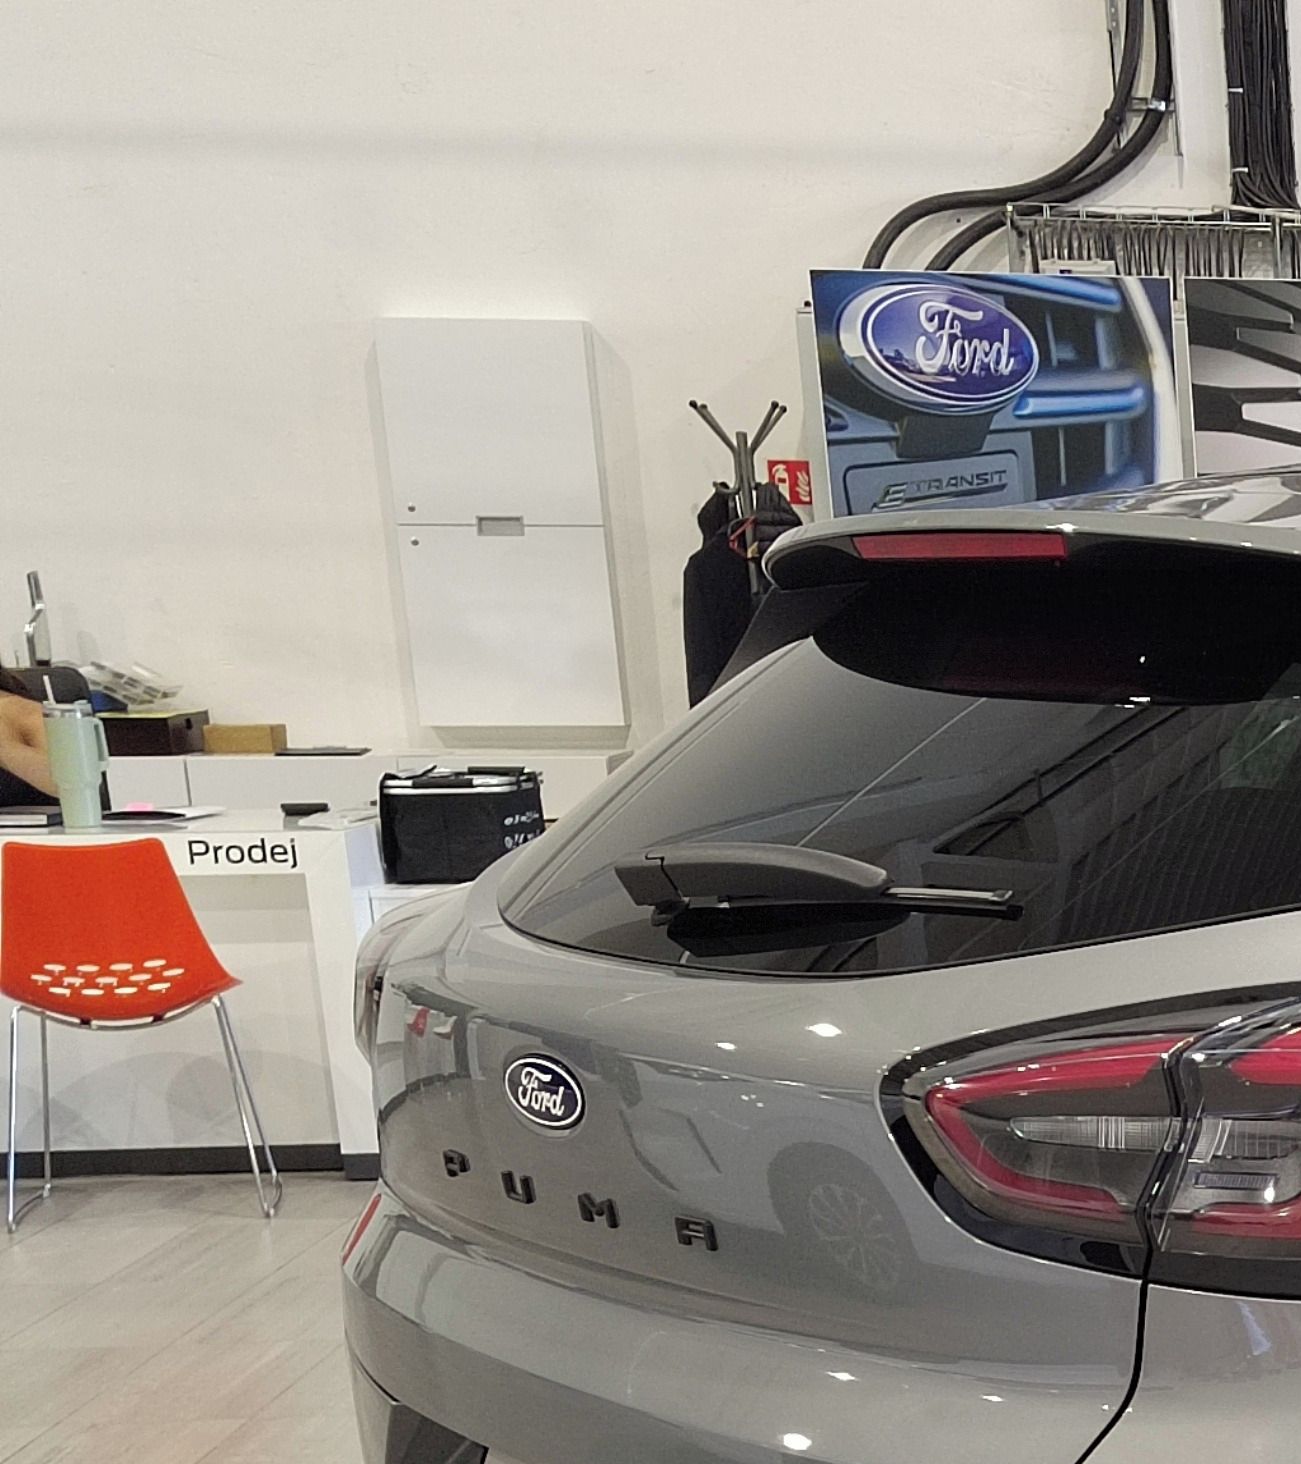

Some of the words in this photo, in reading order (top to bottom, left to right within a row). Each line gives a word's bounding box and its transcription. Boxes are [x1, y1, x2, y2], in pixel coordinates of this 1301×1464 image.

[915, 301, 1014, 376] Ford
[187, 837, 298, 869] Prodej
[517, 1066, 565, 1117] Ford
[442, 1148, 719, 1252] PUMA
